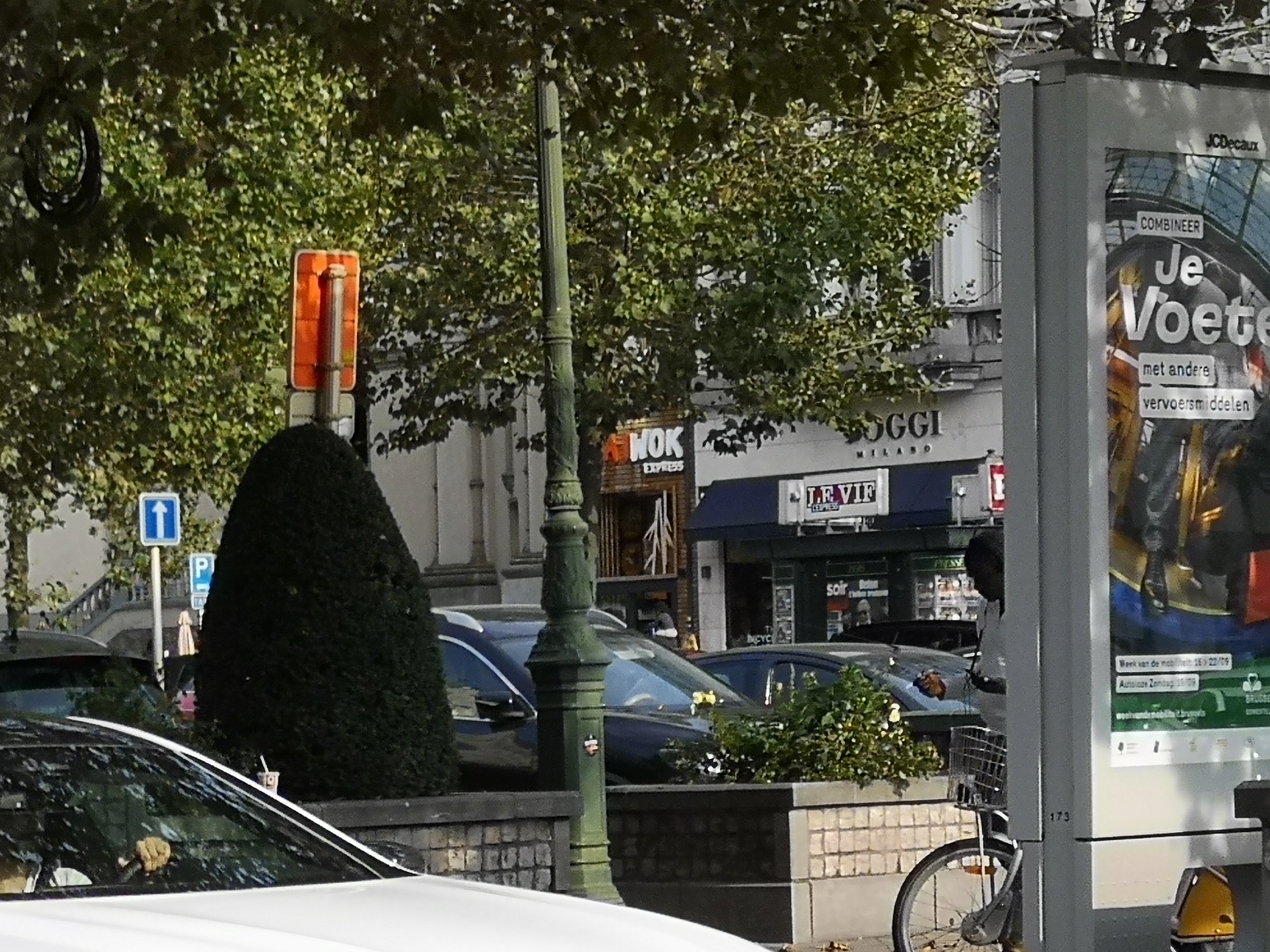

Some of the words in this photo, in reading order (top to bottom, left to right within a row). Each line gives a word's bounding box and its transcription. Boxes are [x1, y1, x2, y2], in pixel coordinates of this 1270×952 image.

[1205, 133, 1259, 152] JCDecaux
[1140, 216, 1201, 234] COMBINEER
[1155, 244, 1205, 286] Je
[1143, 361, 1165, 377] met
[1168, 361, 1210, 378] andere
[1142, 395, 1250, 413] vervoersmiddelen
[630, 426, 684, 462] WOK
[808, 485, 835, 507] LE
[837, 481, 875, 504] VIF
[196, 557, 209, 578] P
[1050, 811, 1070, 822] 173
